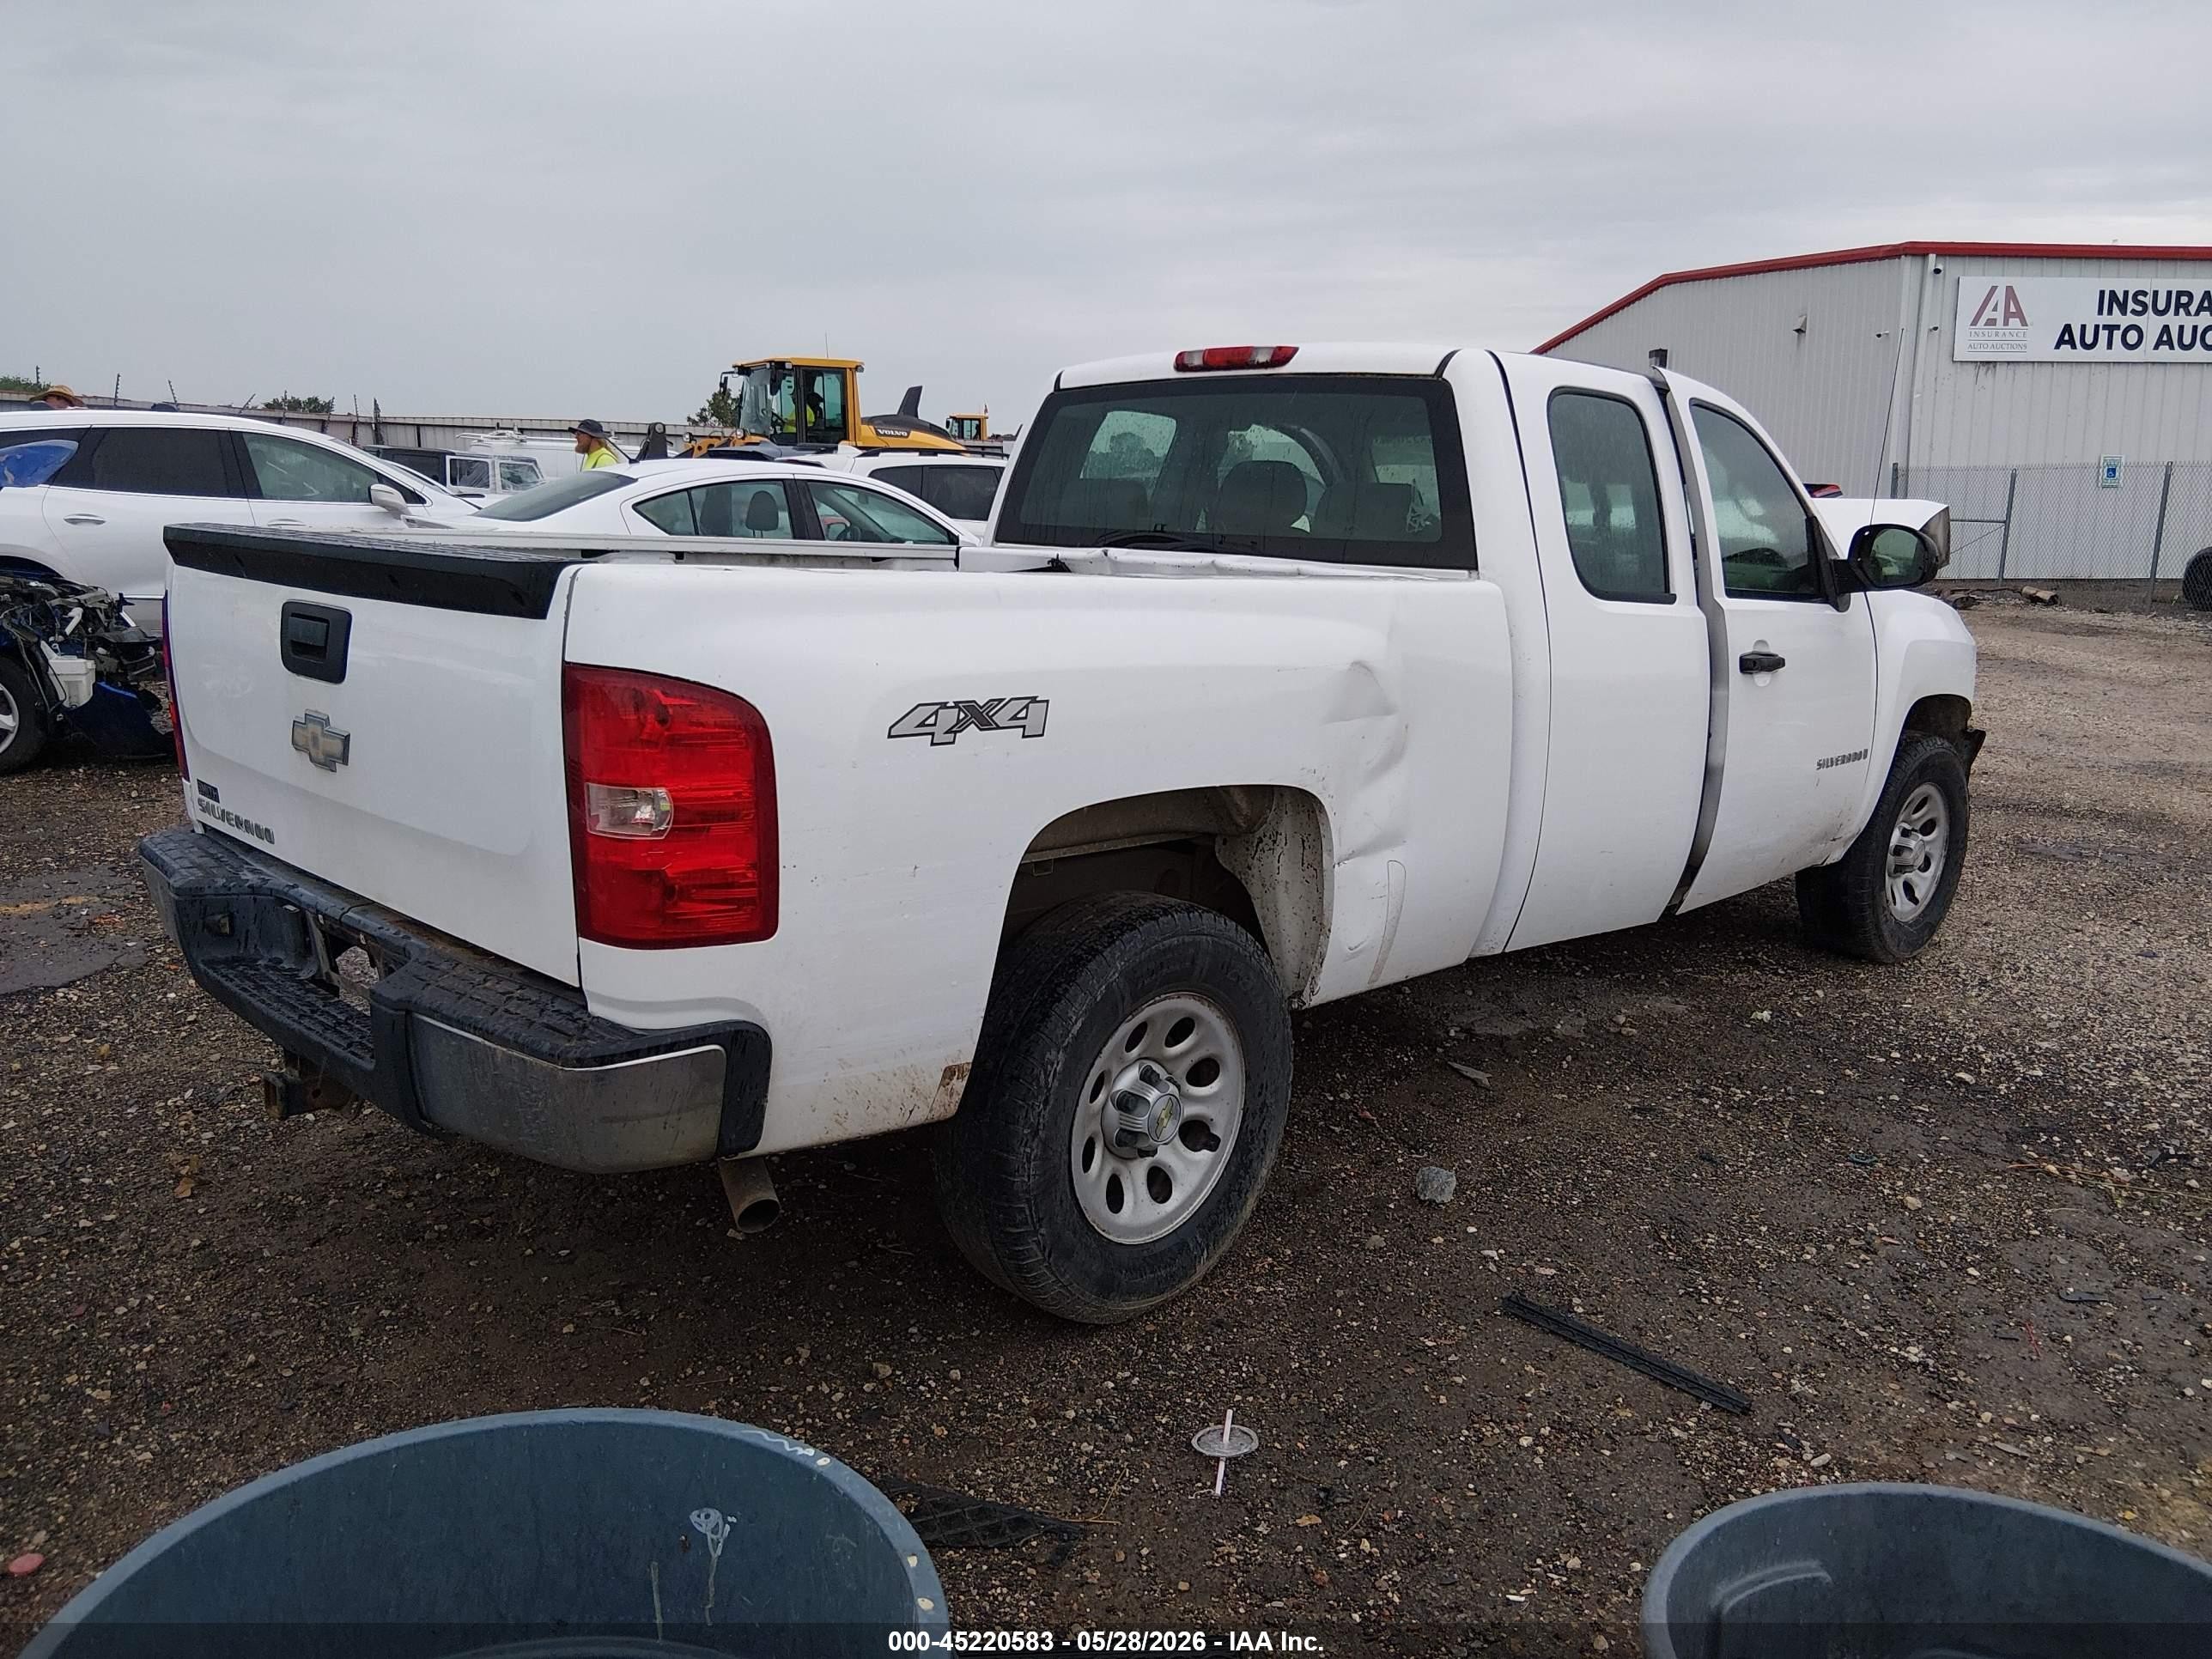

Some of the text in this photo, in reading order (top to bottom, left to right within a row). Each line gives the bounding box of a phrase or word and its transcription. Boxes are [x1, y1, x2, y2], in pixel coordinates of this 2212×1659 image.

[2097, 289, 2212, 317] INSURA
[1990, 343, 2027, 351] AUCTIONS
[2053, 323, 2144, 351] AUTO
[877, 428, 908, 437] VOLVO
[198, 798, 275, 845] SILVERADO
